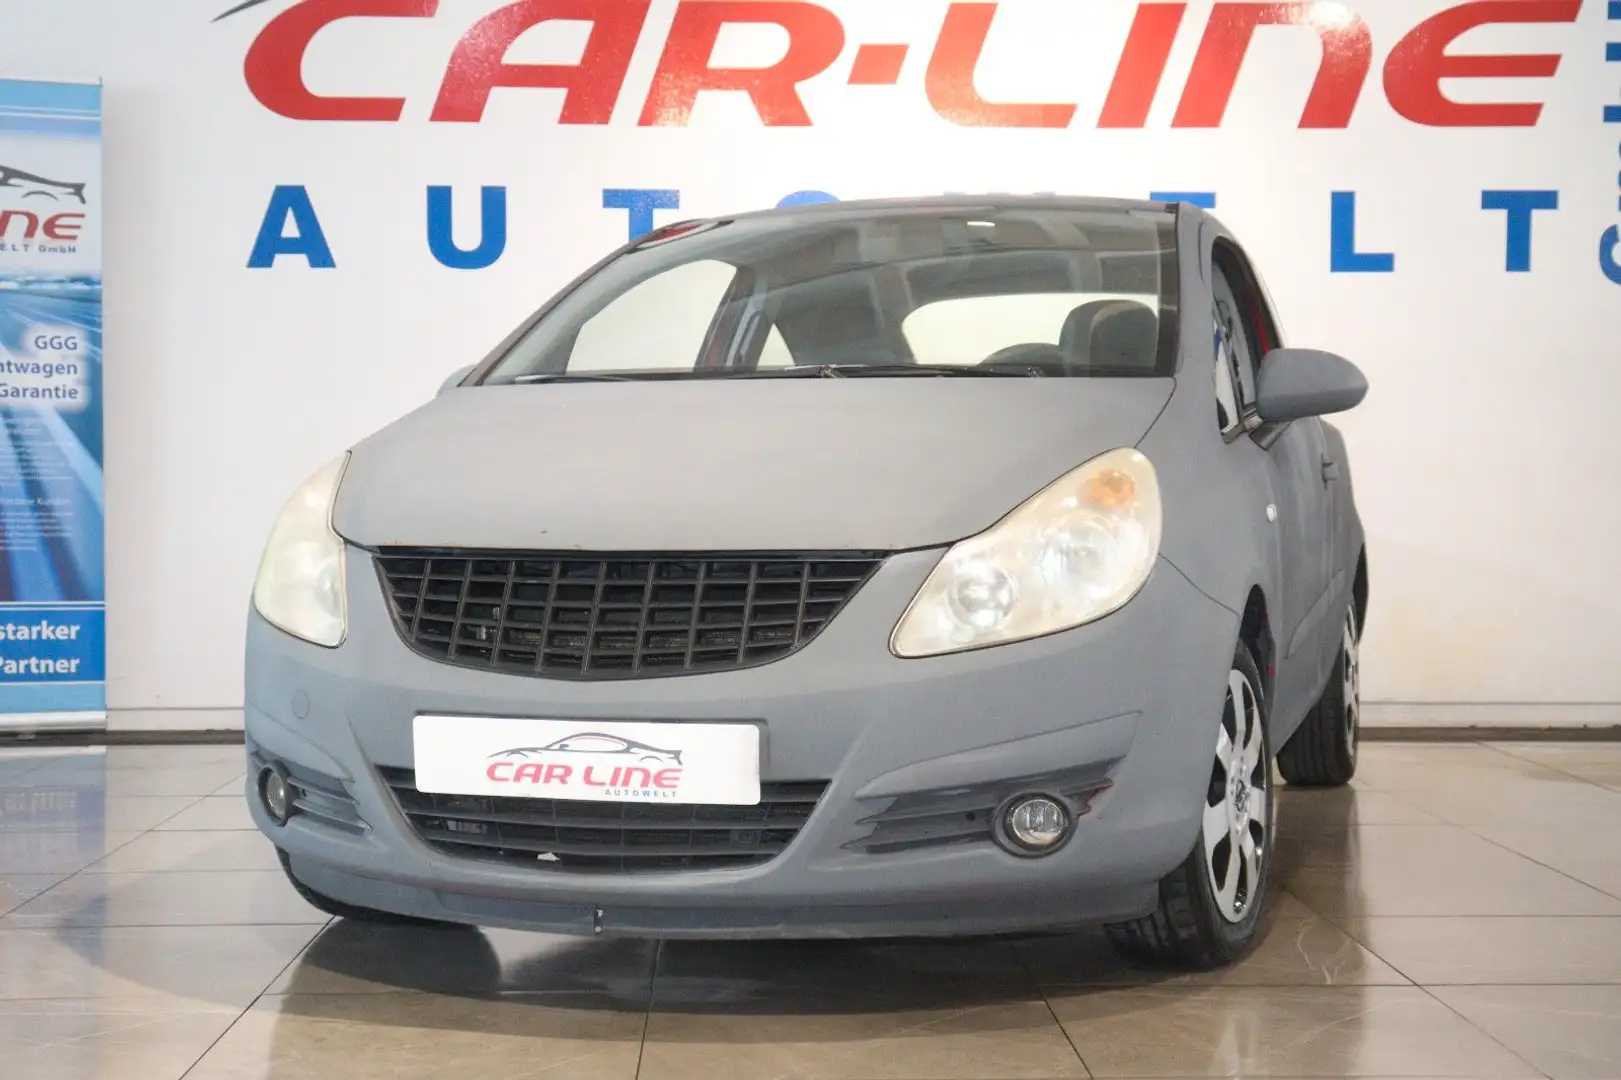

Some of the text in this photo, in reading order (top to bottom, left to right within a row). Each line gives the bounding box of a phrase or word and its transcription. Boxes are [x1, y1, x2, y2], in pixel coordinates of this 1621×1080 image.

[34, 335, 78, 350] GGG
[486, 762, 683, 789] CAR LINE
[604, 789, 677, 798] AUTOWELT
